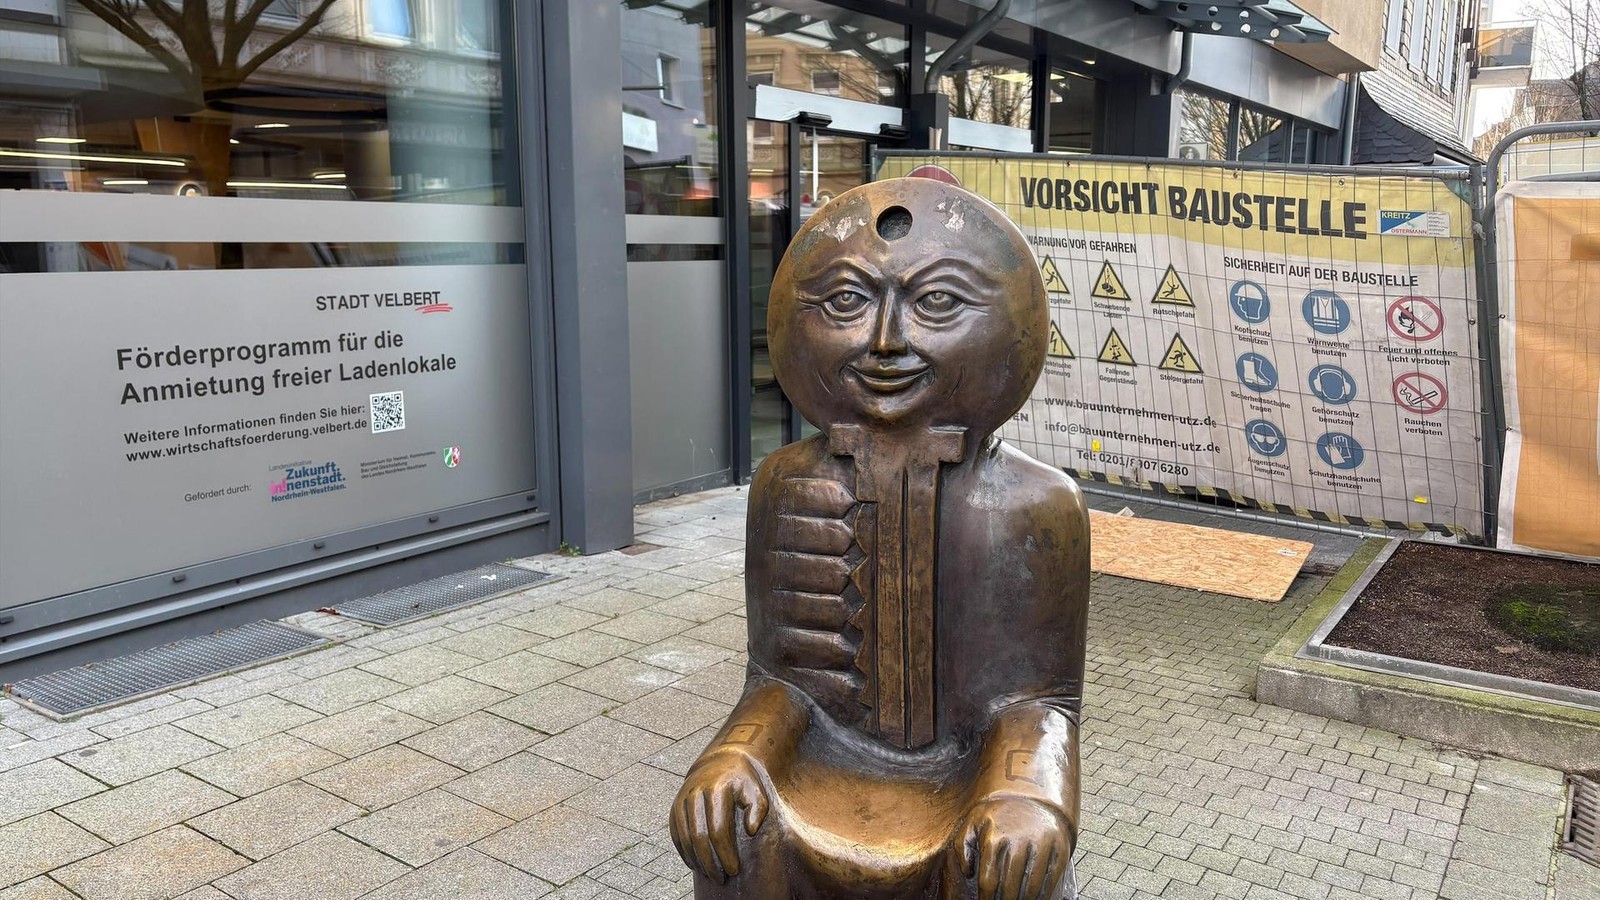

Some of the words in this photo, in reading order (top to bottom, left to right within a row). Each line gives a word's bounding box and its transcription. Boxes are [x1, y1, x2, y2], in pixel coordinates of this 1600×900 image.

[1020, 176, 1159, 214] VORSICHT
[1168, 185, 1367, 240] BAUSTELLE
[1381, 212, 1411, 220] KREITZ
[1026, 234, 1068, 248] WARNUNG
[1069, 238, 1088, 250] VOR
[1090, 240, 1137, 254] GEFAHREN
[1223, 256, 1286, 275] SICHERHEIT
[1288, 264, 1311, 278] AUF
[1314, 268, 1338, 282] DER
[1342, 271, 1419, 287] BAUSTELLE
[316, 294, 370, 311] STADT
[374, 291, 441, 308] VELBERT
[116, 338, 331, 370] Förderprogramm
[338, 332, 368, 352] für
[374, 330, 404, 349] die
[1378, 346, 1402, 354] Feuer
[1424, 348, 1458, 356] offenes
[1386, 355, 1408, 363] Licht
[1411, 357, 1450, 366] verboten
[120, 375, 265, 405] Anmietung
[272, 367, 332, 389] freier
[340, 354, 457, 382] Ladenlokale
[1044, 397, 1217, 428] www.bauunternehmen-utz.de
[1404, 418, 1442, 428] Rauchen
[124, 429, 180, 445] Weitere
[184, 417, 276, 437] Informationen
[280, 411, 316, 424] finden
[320, 408, 338, 419] Sie
[341, 405, 366, 416] hier:
[1405, 426, 1443, 436] verboten
[126, 419, 368, 462] www.wirtschaftsfoerderung.velbert.de
[1044, 421, 1221, 453] info@bauunternehmen-utz.de
[286, 461, 340, 480] Zukunft.
[1076, 450, 1096, 461] Tel:
[1160, 462, 1189, 476] 6280
[184, 486, 225, 502] Gefördert
[226, 484, 252, 496] durch:
